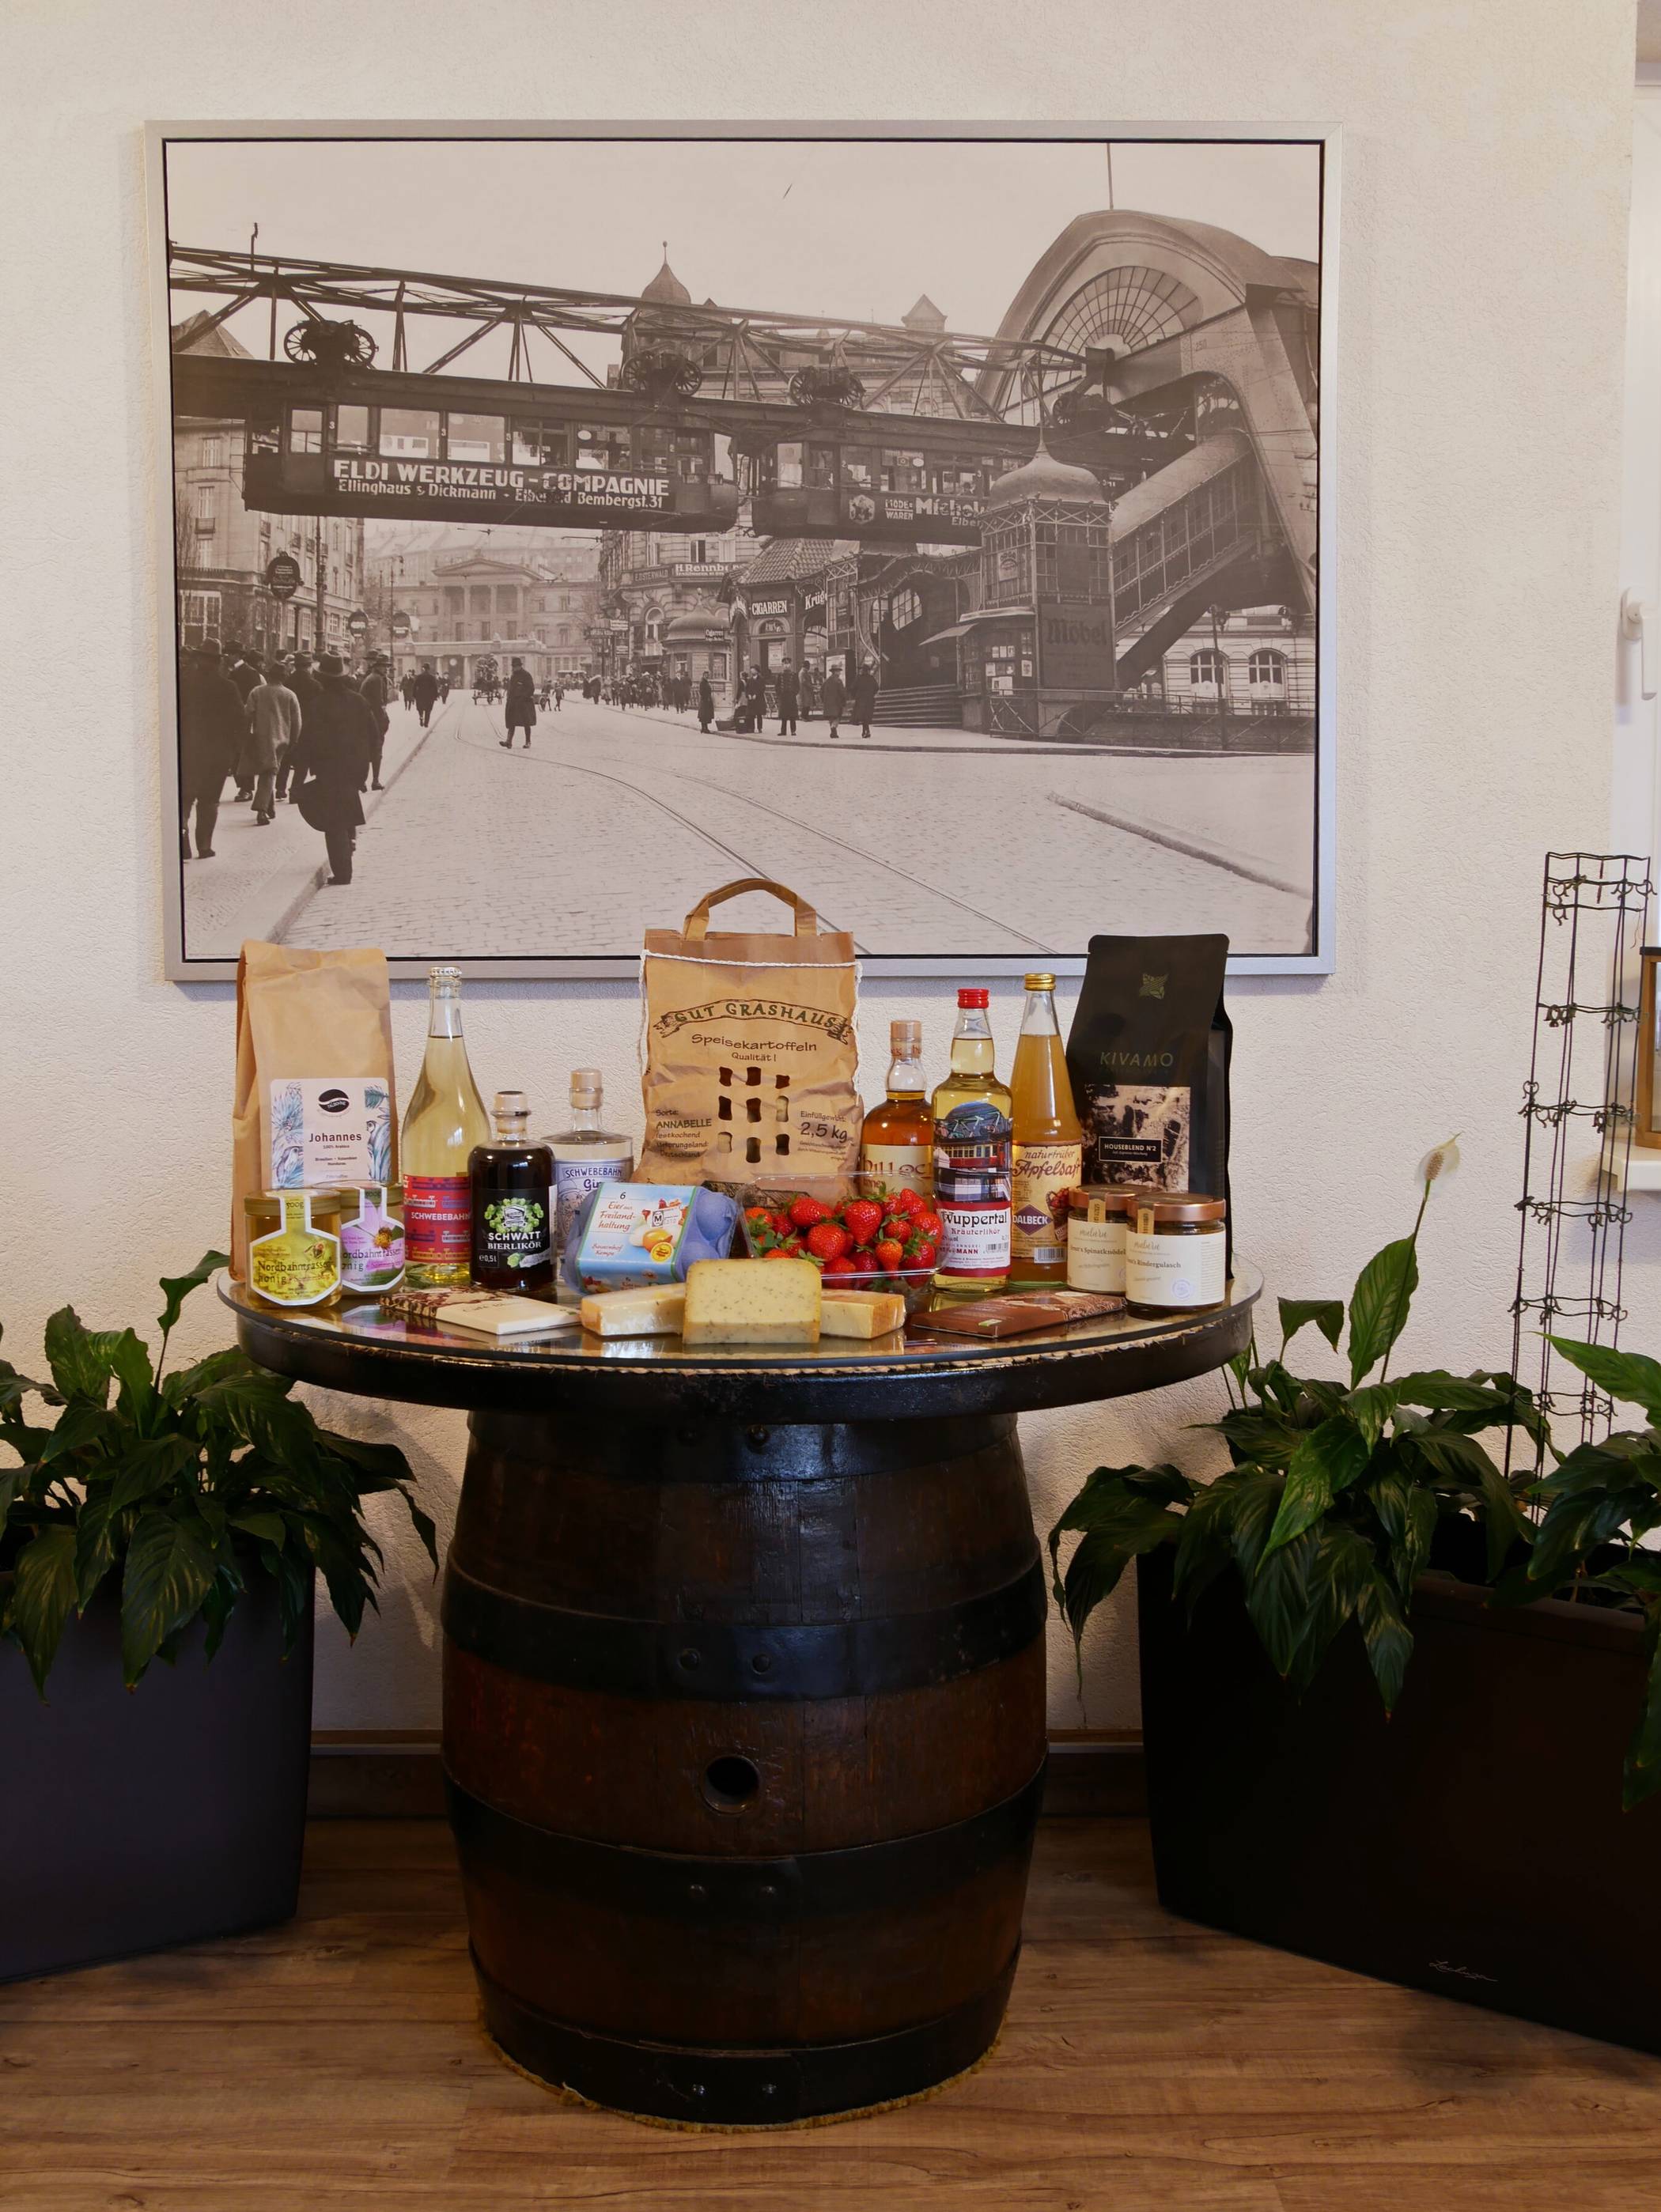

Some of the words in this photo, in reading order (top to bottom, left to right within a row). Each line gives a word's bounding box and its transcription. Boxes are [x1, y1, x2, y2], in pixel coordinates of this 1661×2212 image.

[334, 459, 389, 480] ELDI
[339, 478, 411, 496] Ellinghaus
[428, 483, 497, 500] Dickmann
[886, 510, 914, 520] WAREN
[804, 590, 828, 611] Krüg
[751, 599, 787, 615] CIGARREN
[1044, 617, 1108, 645] Möbel
[675, 1006, 715, 1023] GUT
[725, 1002, 836, 1027] GRASHAUS
[691, 1034, 817, 1052] Speisekartoffeln
[732, 1052, 772, 1062] Qualität
[1100, 1052, 1174, 1067] KIVAMO
[655, 1118, 712, 1129] ANNABELLE
[309, 1133, 362, 1143] Johannes
[800, 1121, 828, 1138] 2,5
[831, 1125, 848, 1144] kg
[1024, 1149, 1076, 1159] naturtrüber
[565, 1167, 622, 1178] SCHWEBEBAHN
[1011, 1157, 1081, 1180] Apfelsaft
[607, 1201, 624, 1210] Eier
[411, 1212, 470, 1221] SCHWEBEBAHN
[941, 1211, 1007, 1227] Wuppertal
[598, 1221, 631, 1232] haltung
[488, 1231, 541, 1241] SCHWATT
[487, 1240, 542, 1250] BIERLIKÖR
[1137, 1257, 1182, 1269] Rindergulasch
[258, 1274, 287, 1285] honig
